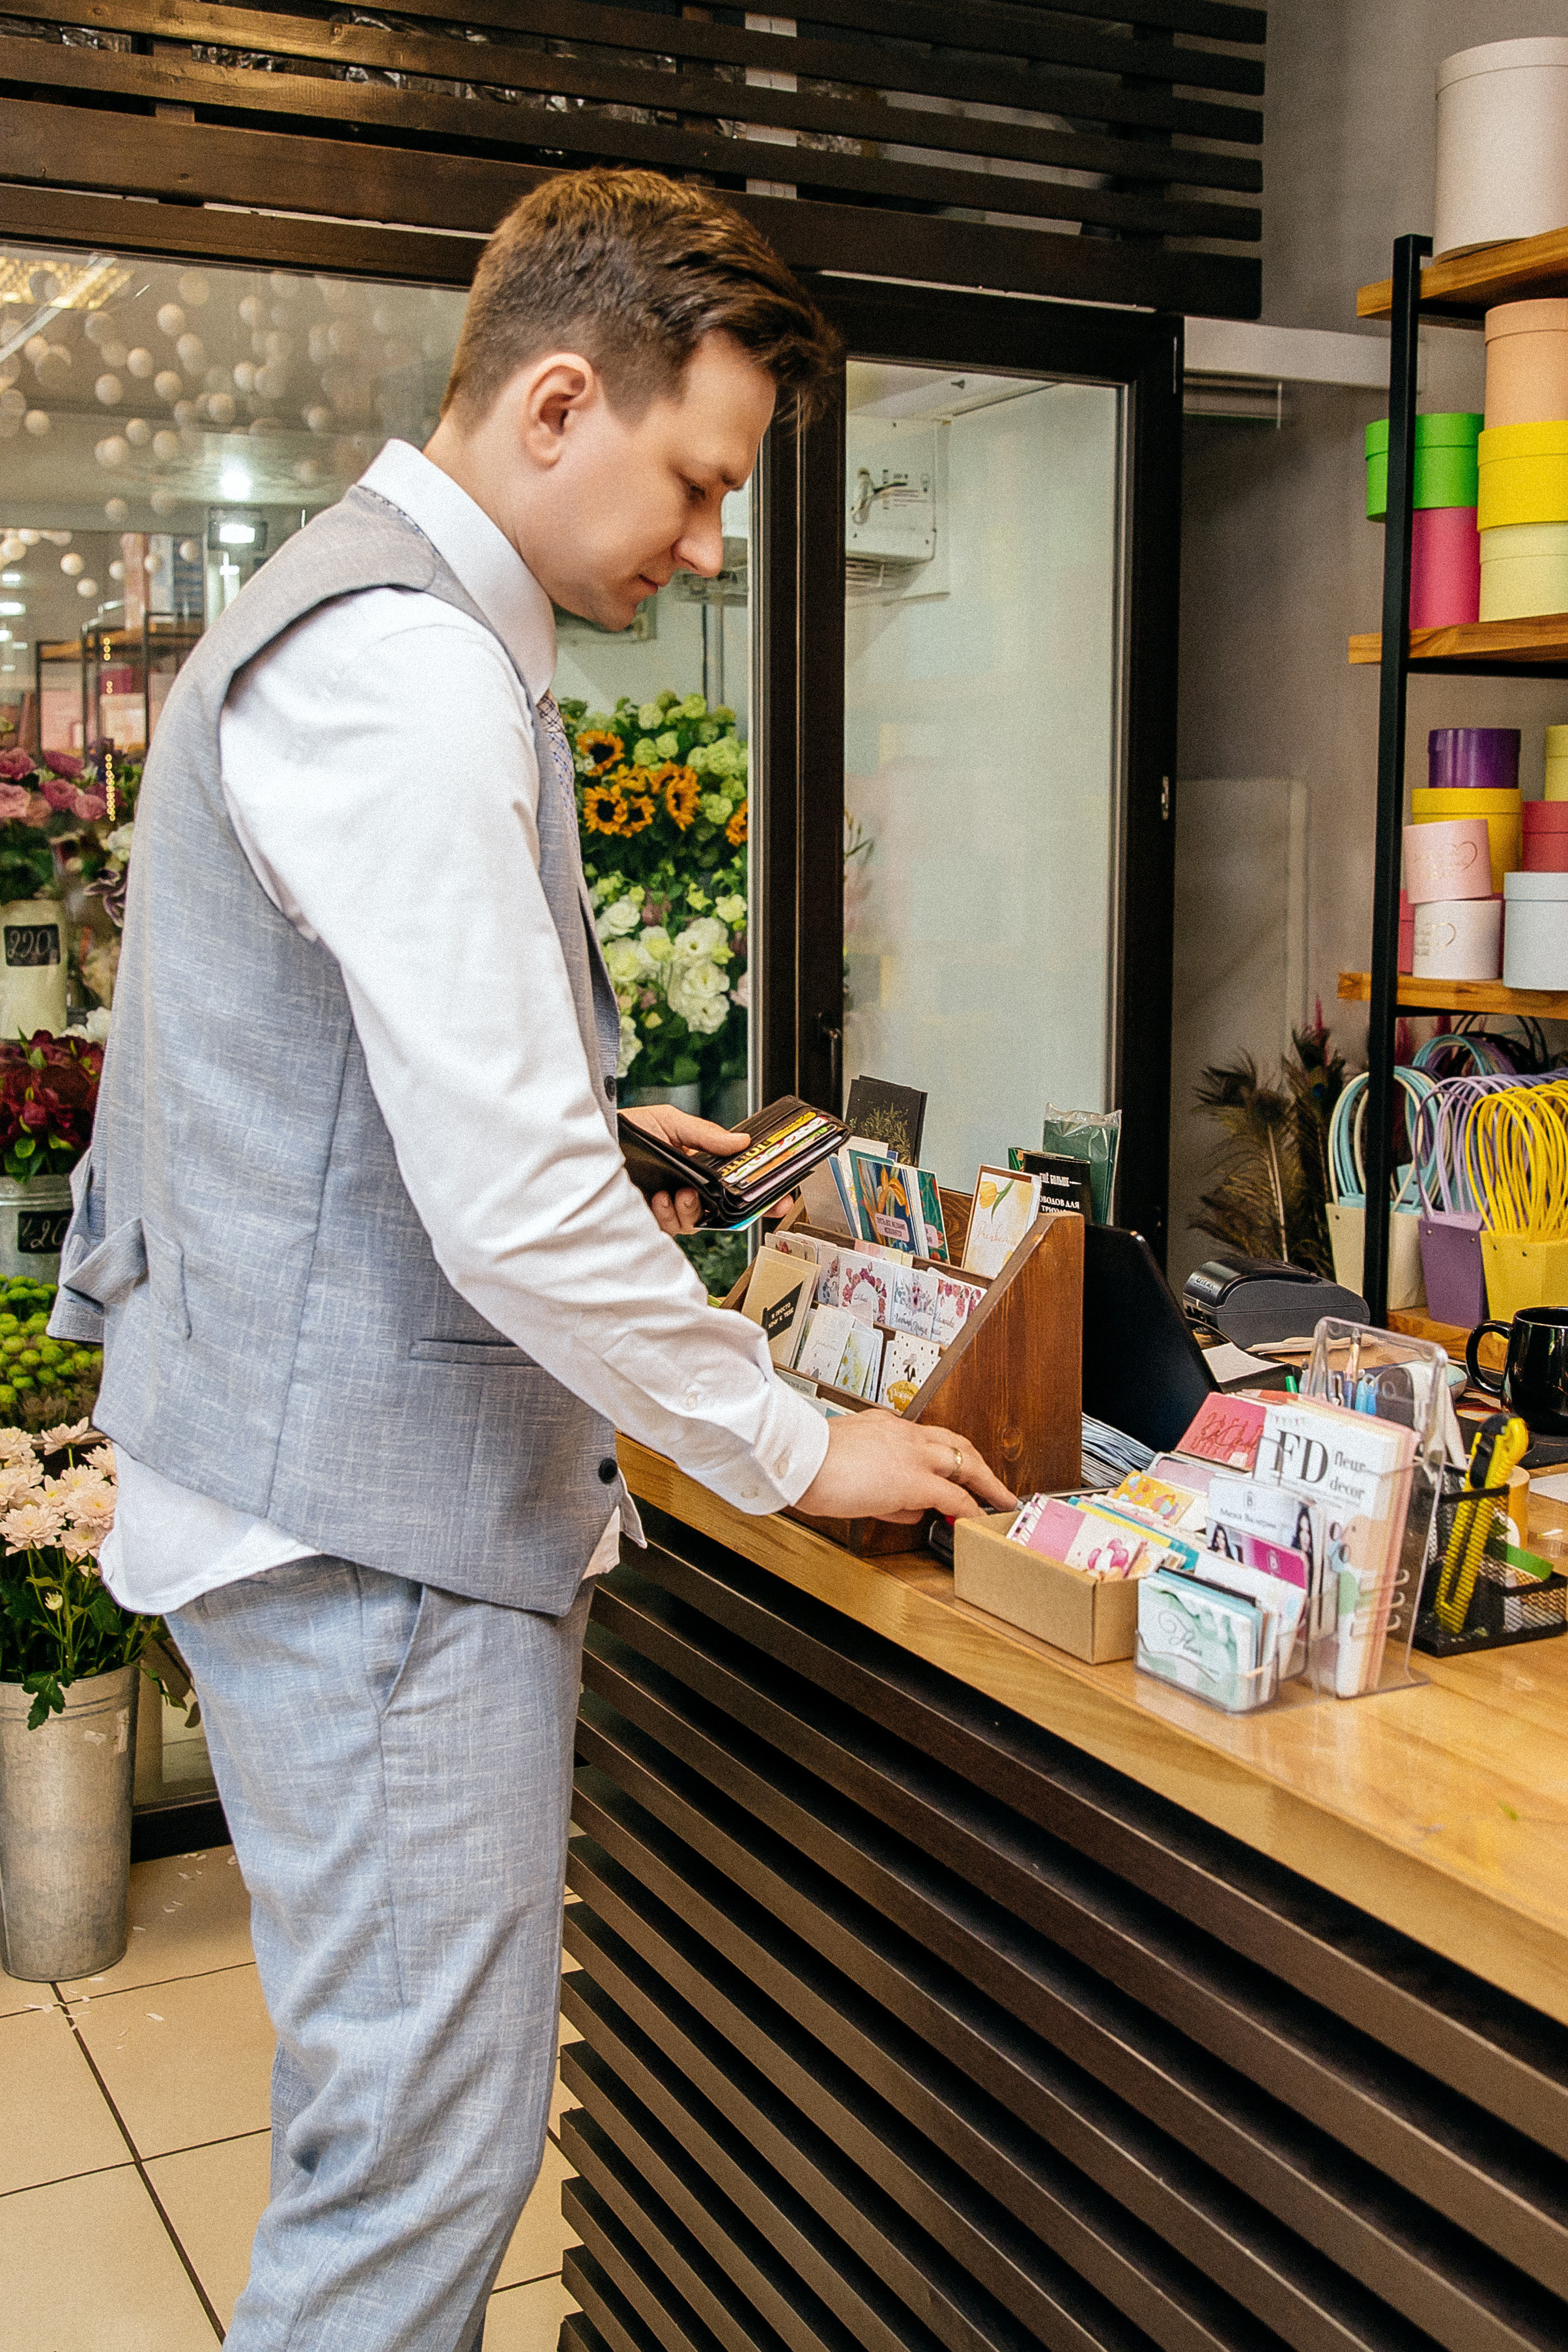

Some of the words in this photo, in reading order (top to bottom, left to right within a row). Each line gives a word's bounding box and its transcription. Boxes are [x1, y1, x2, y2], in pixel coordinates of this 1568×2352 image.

[7, 929, 51, 958] 220
[1039, 1196, 1065, 1207] ОВОДОВ
[1065, 1200, 1080, 1209] ДЛЯ
[1270, 1429, 1328, 1484] FD
[1335, 1450, 1366, 1473] fleur
[1330, 1476, 1365, 1499] decor
